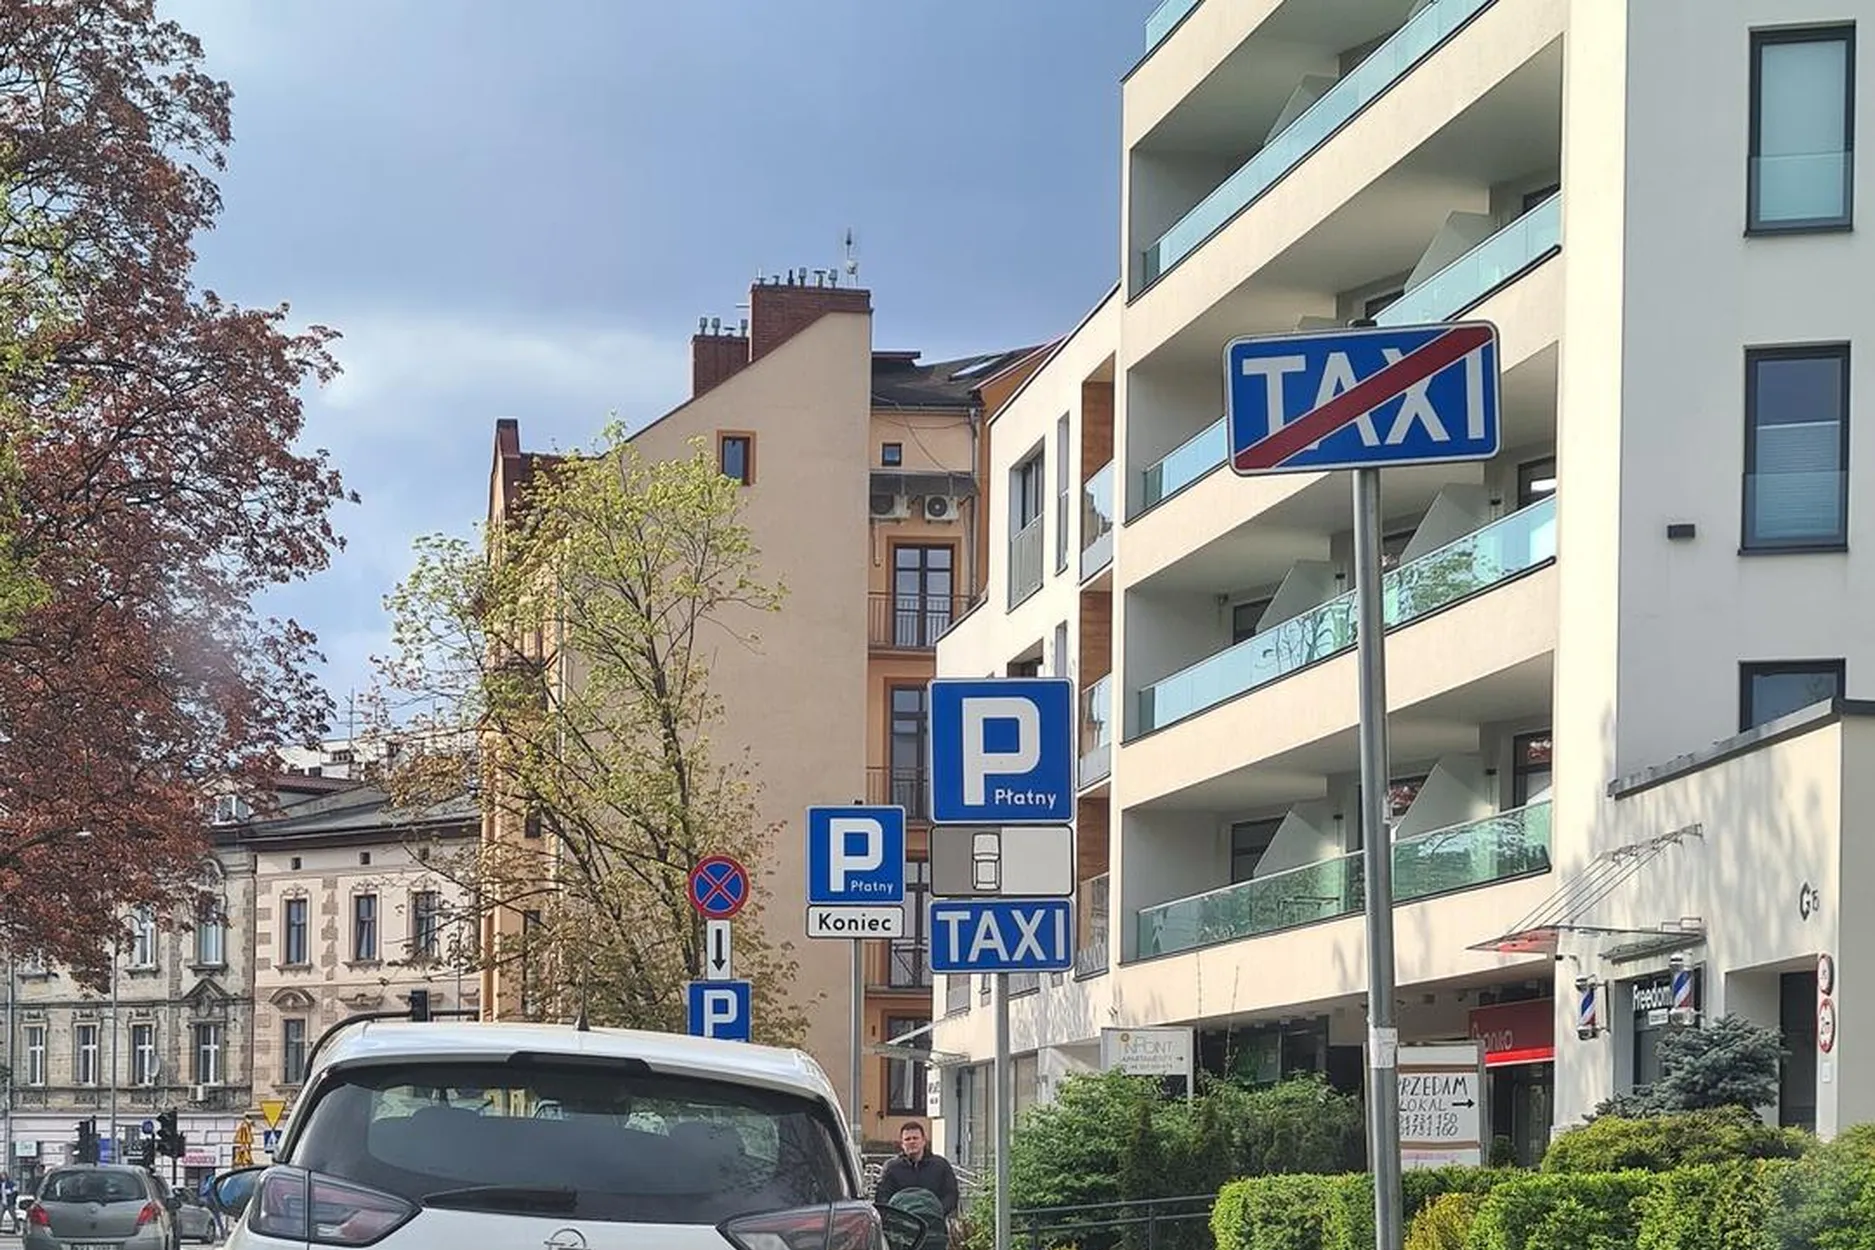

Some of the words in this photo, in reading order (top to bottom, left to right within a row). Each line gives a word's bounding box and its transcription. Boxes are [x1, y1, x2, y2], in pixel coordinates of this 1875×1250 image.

[1241, 347, 1485, 450] TAXI
[963, 697, 1041, 805] P
[995, 788, 1057, 808] Płatny
[829, 818, 883, 892] P
[850, 880, 894, 894] Płatny
[817, 913, 892, 932] Koniec
[936, 909, 1065, 963] TAXI
[704, 989, 737, 1037] P
